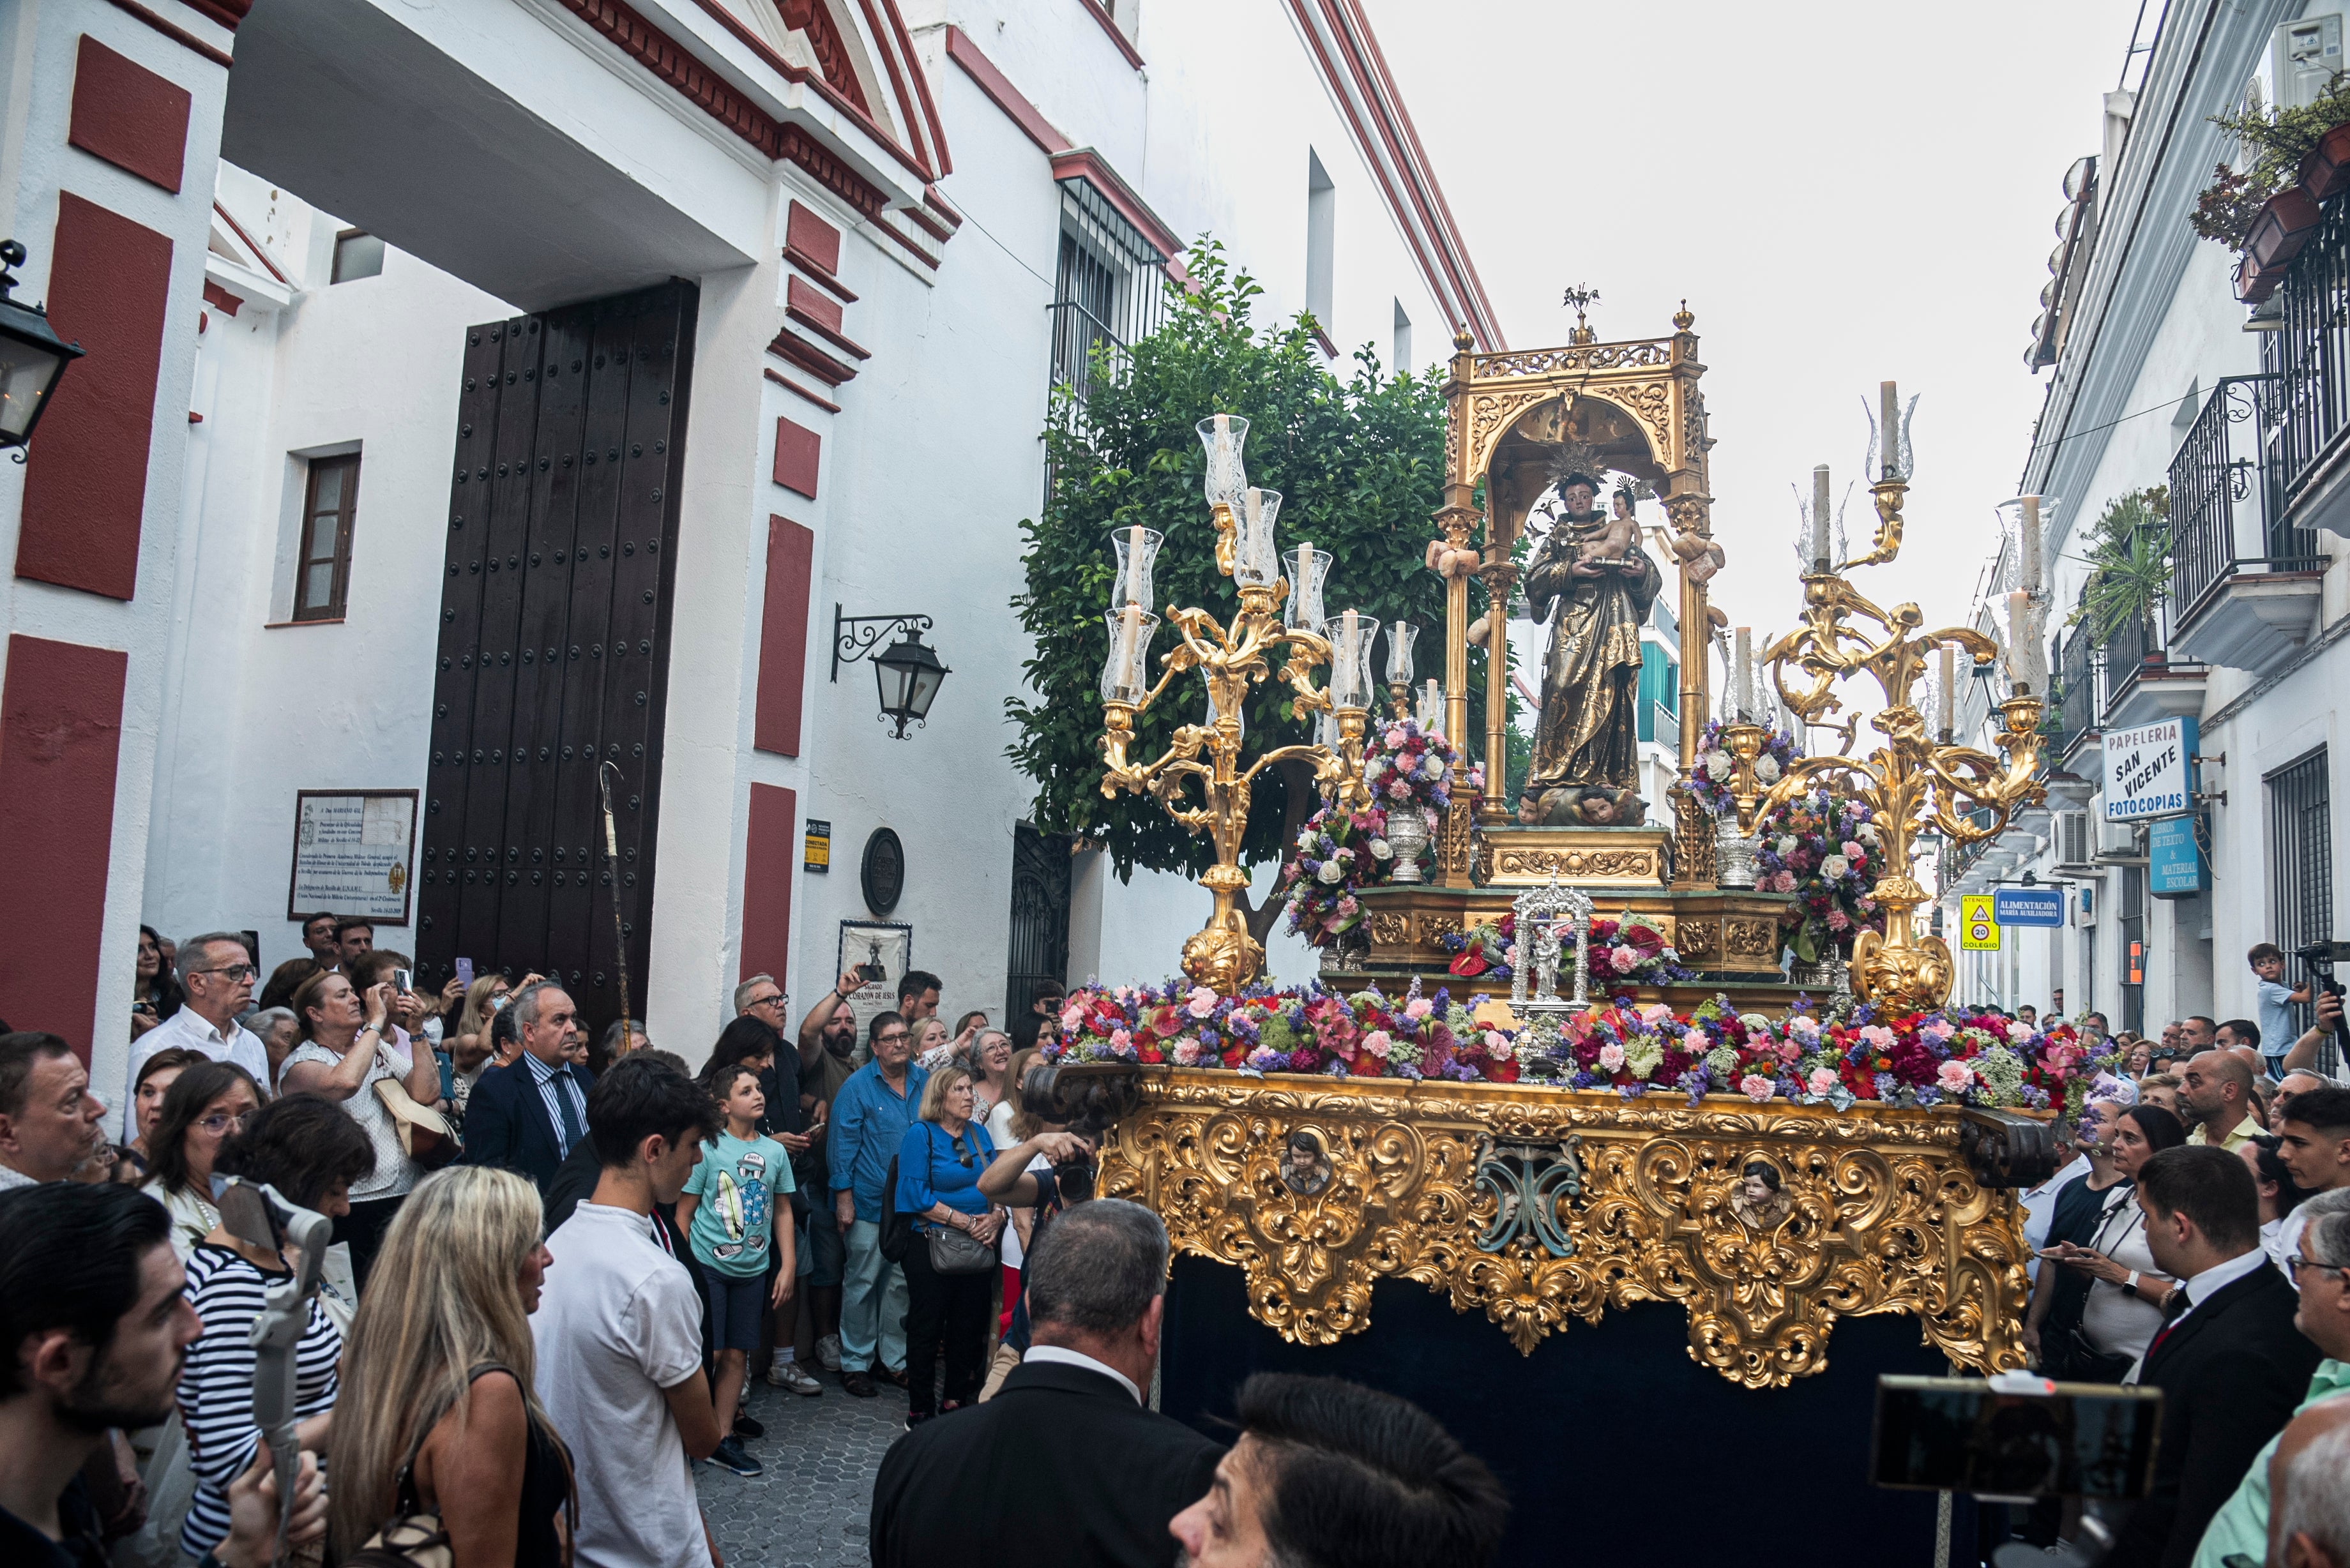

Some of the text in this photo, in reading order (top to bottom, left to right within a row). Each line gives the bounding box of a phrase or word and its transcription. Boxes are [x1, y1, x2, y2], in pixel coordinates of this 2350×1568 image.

[2109, 725, 2176, 750] PAPELERIA
[2116, 750, 2141, 782] SAN
[2125, 745, 2176, 798] VICENTE
[2109, 793, 2182, 816] FOTOCOPIAS
[2152, 822, 2175, 834] LIBROS
[2152, 833, 2184, 847] DE TEXTO
[2170, 850, 2176, 859] &
[2162, 862, 2196, 875] MATERIAL
[2166, 875, 2197, 887] ESCOLAR
[1999, 901, 2057, 910] ALIMENTACIÓN
